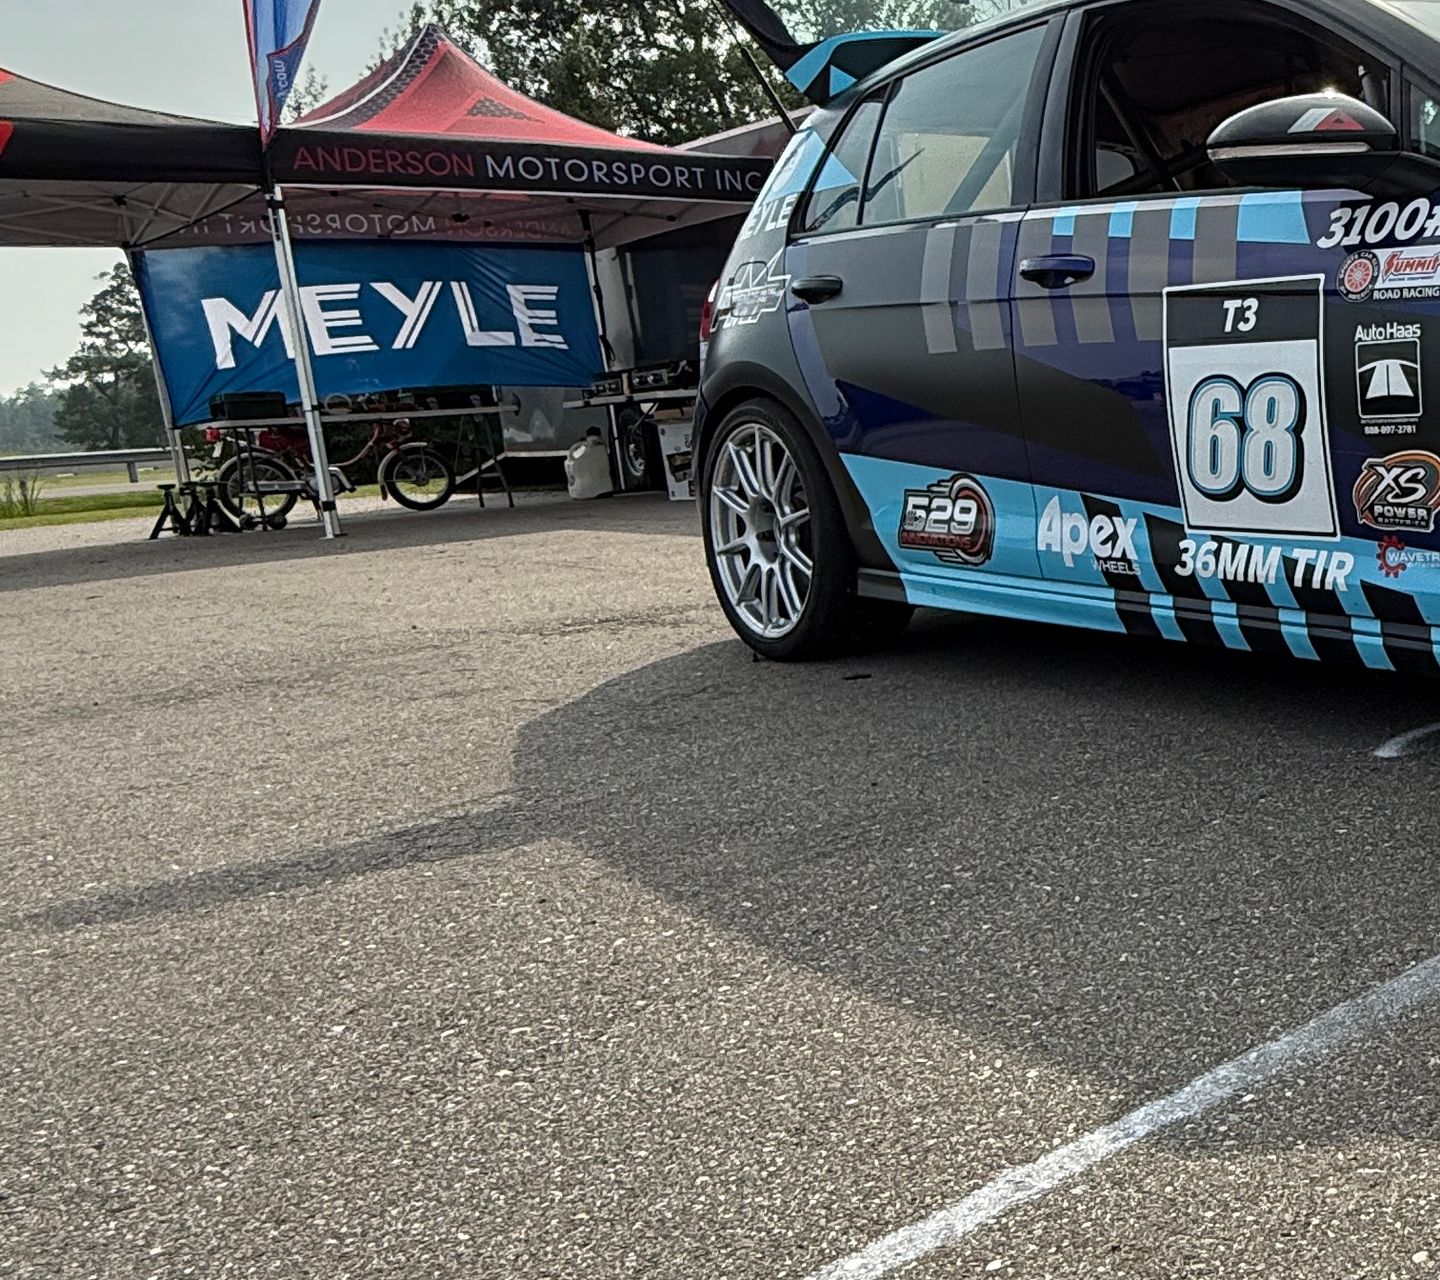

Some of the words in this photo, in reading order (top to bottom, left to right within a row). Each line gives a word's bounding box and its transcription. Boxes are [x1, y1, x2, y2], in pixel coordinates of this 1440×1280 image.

[293, 146, 475, 177] ANDERSON
[485, 154, 705, 189] MOTORSPORT
[716, 169, 762, 192] INC
[1222, 297, 1259, 334] T3
[1373, 288, 1401, 300] ROAD
[1402, 286, 1440, 299] RACING
[200, 280, 570, 370] MEYLE
[1186, 373, 1306, 503] 68
[1361, 465, 1427, 512] XS
[901, 496, 978, 535] 529
[1037, 494, 1139, 568] Apex
[1373, 505, 1429, 521] POWER
[1090, 558, 1142, 576] WHEELS
[1174, 539, 1282, 585] 36MM
[1290, 548, 1354, 593] TIR
